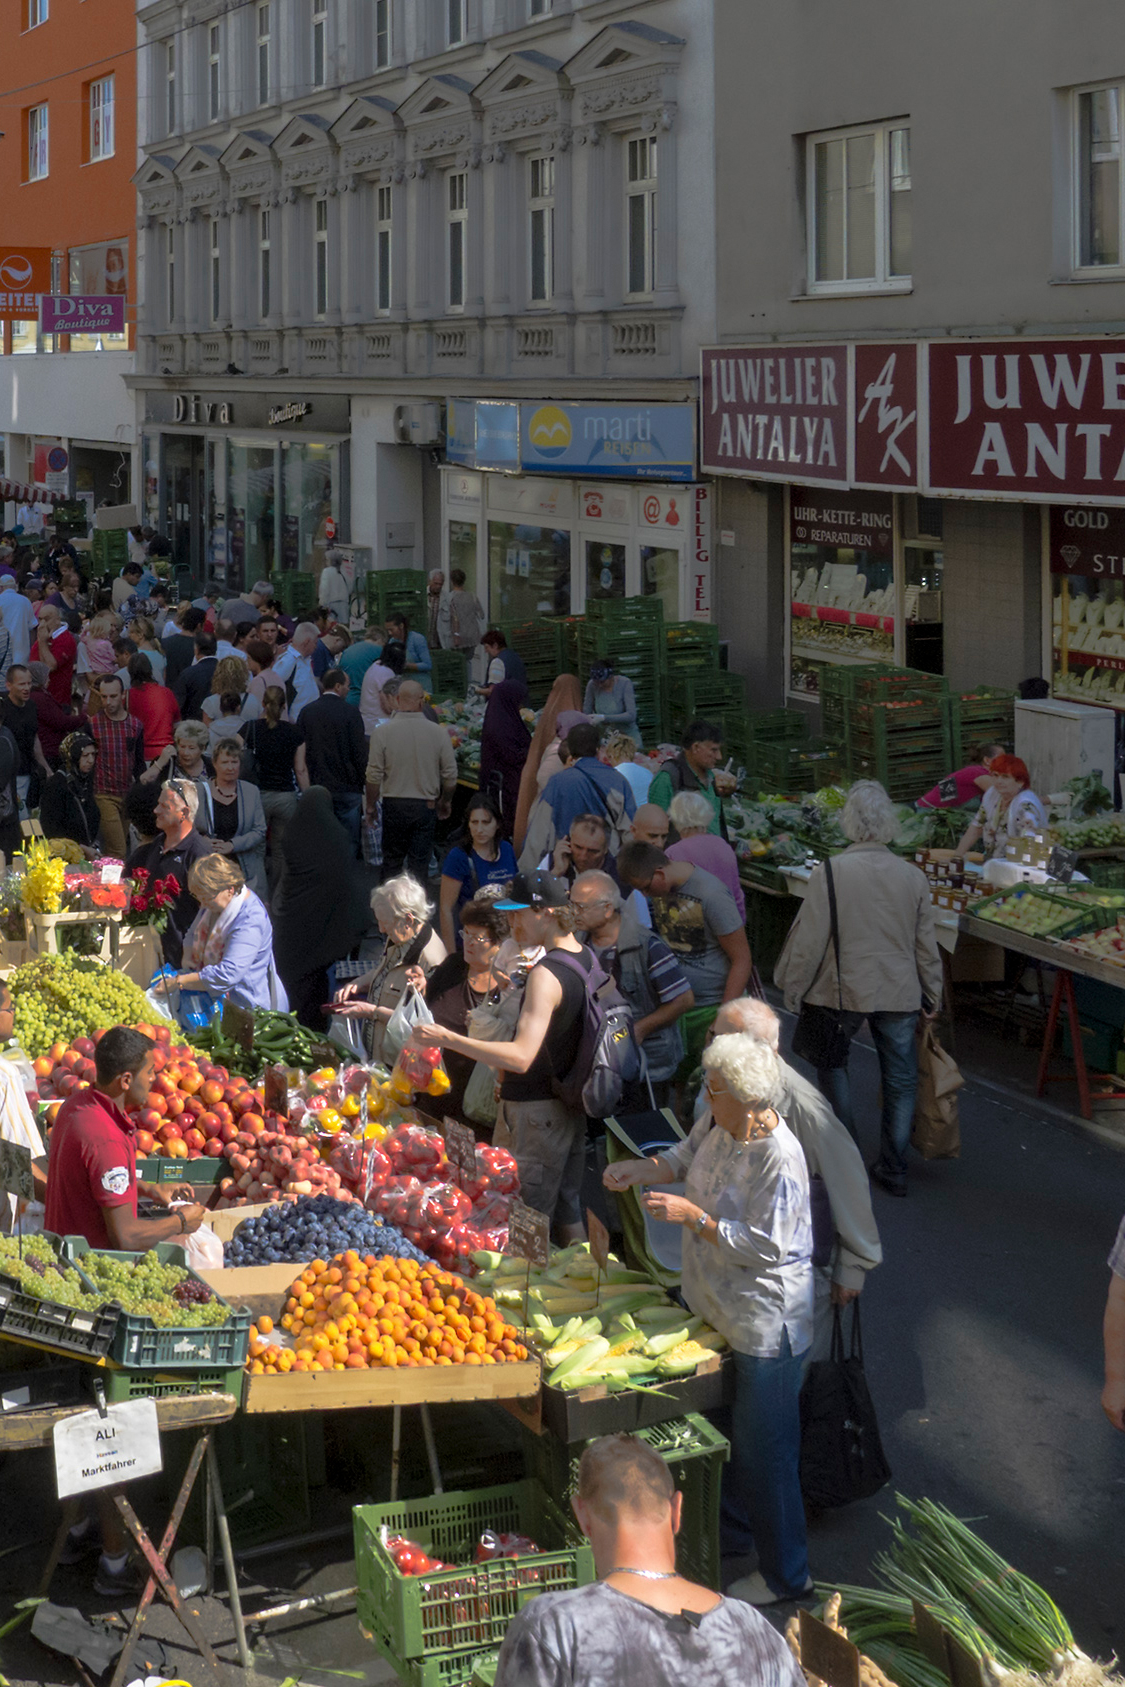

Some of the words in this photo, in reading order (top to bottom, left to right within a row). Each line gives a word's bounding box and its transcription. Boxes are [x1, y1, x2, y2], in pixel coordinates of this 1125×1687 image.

[52, 298, 115, 316] Diva
[54, 317, 111, 331] Boutique
[711, 357, 839, 415] JUWELIER
[173, 394, 230, 424] Diva
[583, 411, 651, 441] marti
[603, 441, 651, 456] REISEN
[717, 413, 838, 467] ANTALYA
[971, 422, 1125, 481] ANT
[695, 488, 709, 563] BILLIG
[795, 506, 892, 529] UHR-KETTE-RING
[1064, 510, 1109, 529] GOLD
[811, 529, 872, 547] REPARATUREN
[95, 1427, 116, 1441] ALI
[81, 1458, 137, 1478] Marktfahrer
